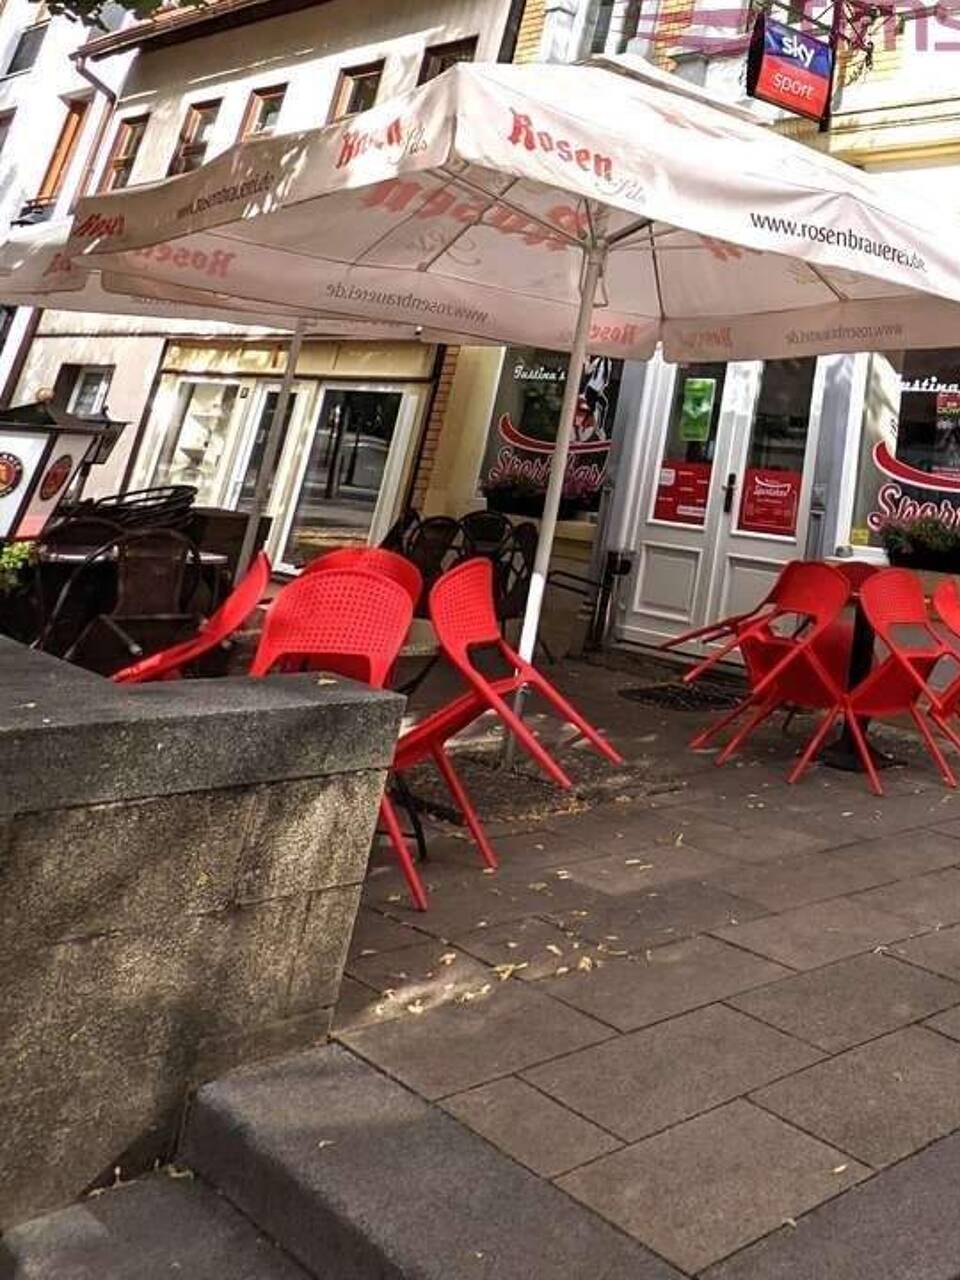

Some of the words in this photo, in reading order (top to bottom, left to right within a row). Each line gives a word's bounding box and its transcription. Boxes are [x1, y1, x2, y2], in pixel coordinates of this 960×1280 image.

[782, 35, 815, 68] sky
[772, 72, 815, 100] sport
[508, 106, 613, 182] Rosen
